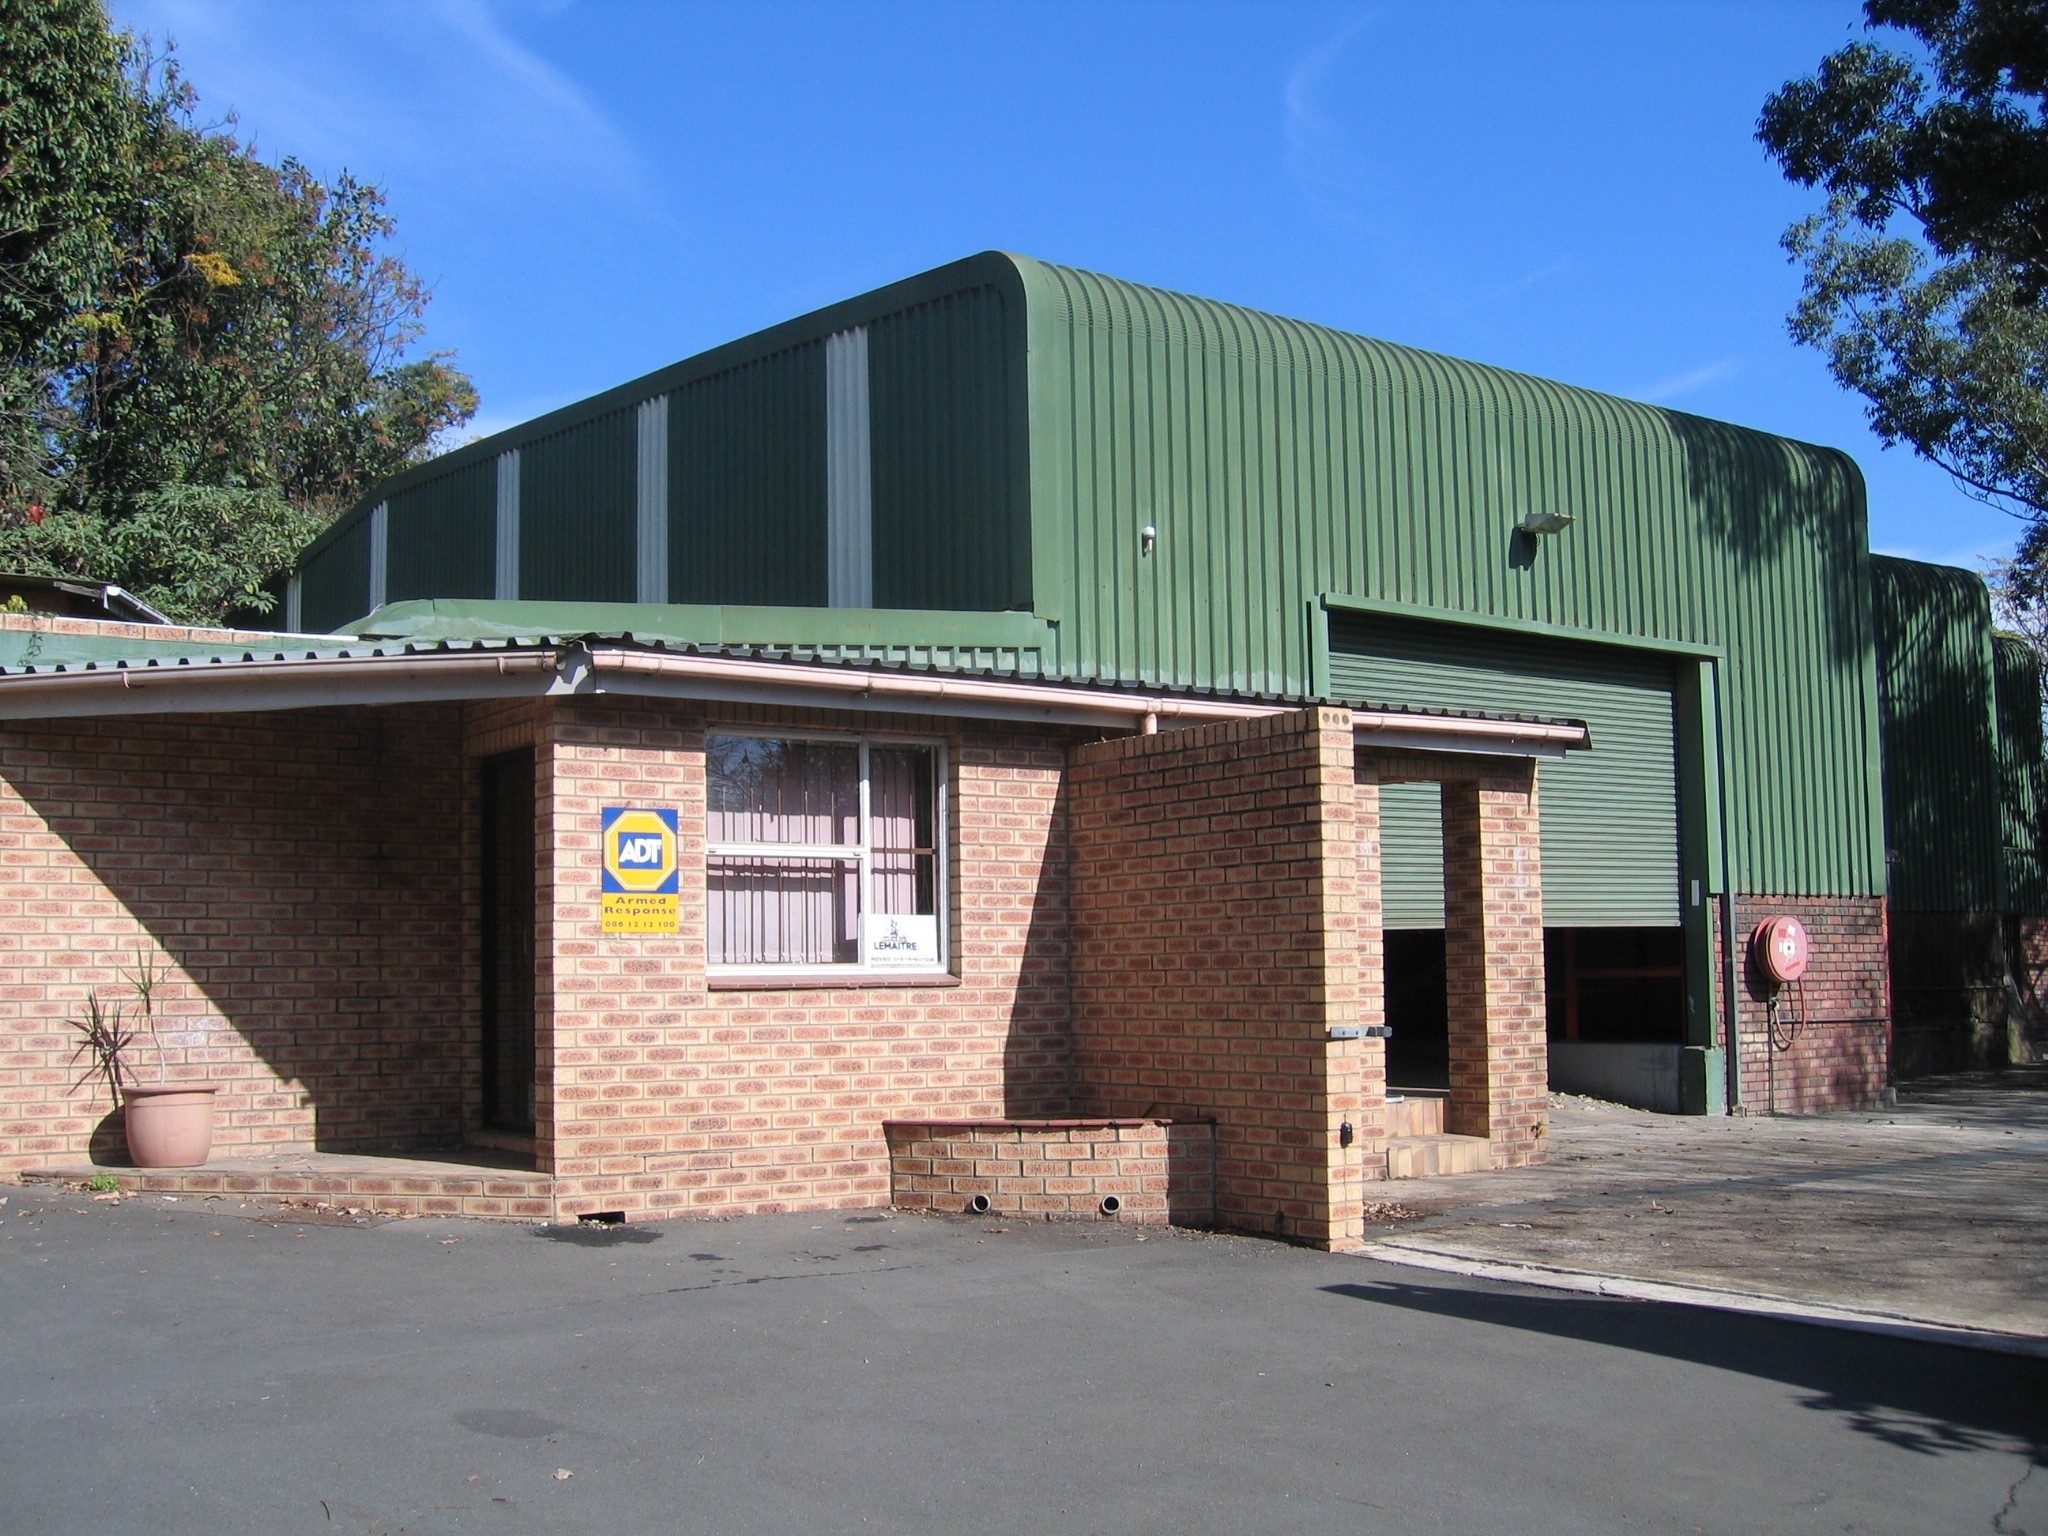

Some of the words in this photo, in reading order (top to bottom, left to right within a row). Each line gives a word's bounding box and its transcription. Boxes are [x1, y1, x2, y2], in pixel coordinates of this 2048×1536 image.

[619, 838, 662, 864] ADT
[615, 896, 666, 904] Armed
[604, 906, 676, 916] Response
[873, 941, 917, 951] LEMAITRE
